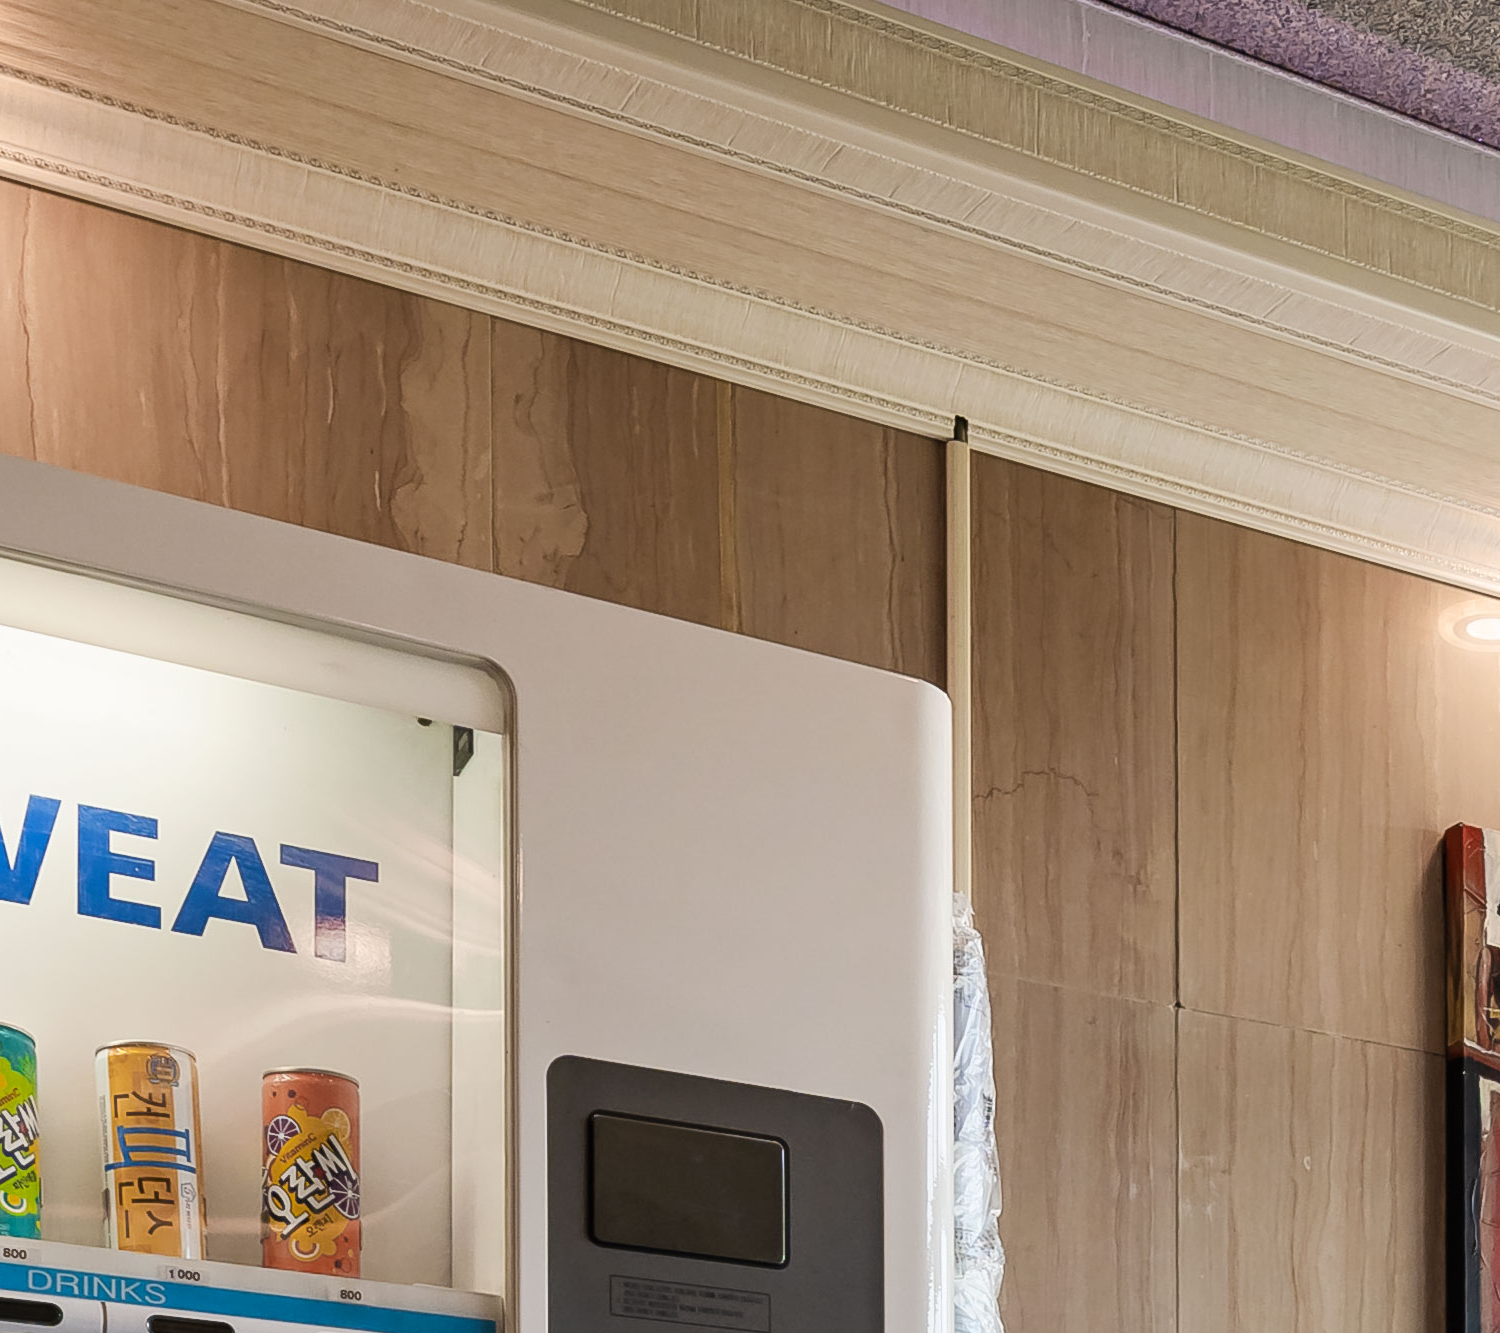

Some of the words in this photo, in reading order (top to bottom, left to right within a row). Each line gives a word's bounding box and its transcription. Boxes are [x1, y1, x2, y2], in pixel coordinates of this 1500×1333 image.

[104, 1090, 197, 1240] 컨피던스
[266, 1134, 358, 1240] 오란씨
[2, 1247, 27, 1260] 800
[28, 1268, 168, 1304] DRINKS
